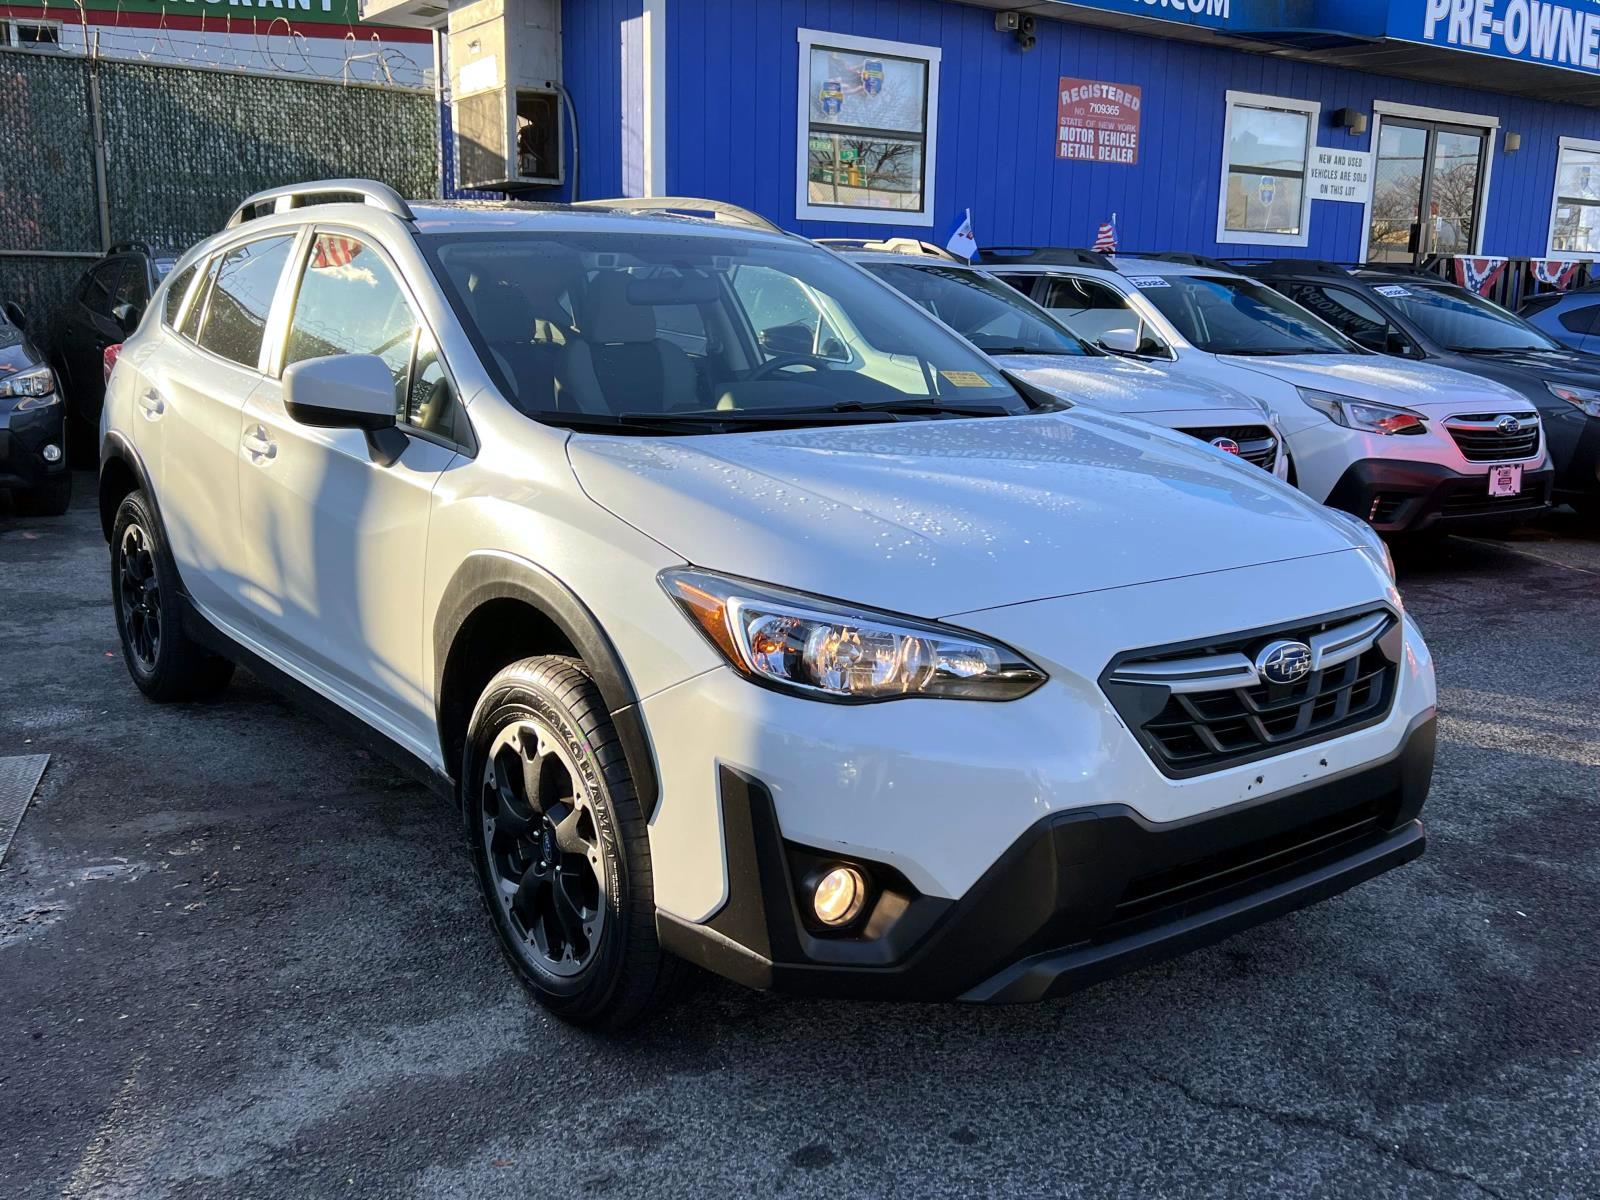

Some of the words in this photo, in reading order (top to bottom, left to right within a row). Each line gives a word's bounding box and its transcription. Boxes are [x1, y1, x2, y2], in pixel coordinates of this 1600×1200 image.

[1423, 0, 1600, 69] PRE-OWNE
[1061, 84, 1140, 111] REGISTERED
[1089, 103, 1120, 116] 7109365
[1061, 117, 1083, 127] STATE
[1086, 119, 1096, 128] OF
[1098, 121, 1115, 130] NEW
[1117, 123, 1137, 133] YORK
[1060, 126, 1094, 144] MOTOR
[1098, 130, 1136, 148] VEHICLE
[1060, 142, 1095, 159] RETAIL
[1098, 146, 1134, 163] DEALER
[1319, 153, 1332, 164] NEW
[1334, 155, 1346, 166] AND
[1347, 157, 1362, 168] USED
[1311, 168, 1338, 180] VEHICLES
[1340, 170, 1351, 181] ARE
[1352, 172, 1367, 183] SOLD
[1320, 184, 1328, 194] ON
[1330, 185, 1343, 195] THIS
[1345, 186, 1355, 196] LOT
[538, 701, 615, 858] YOKOHAMA
